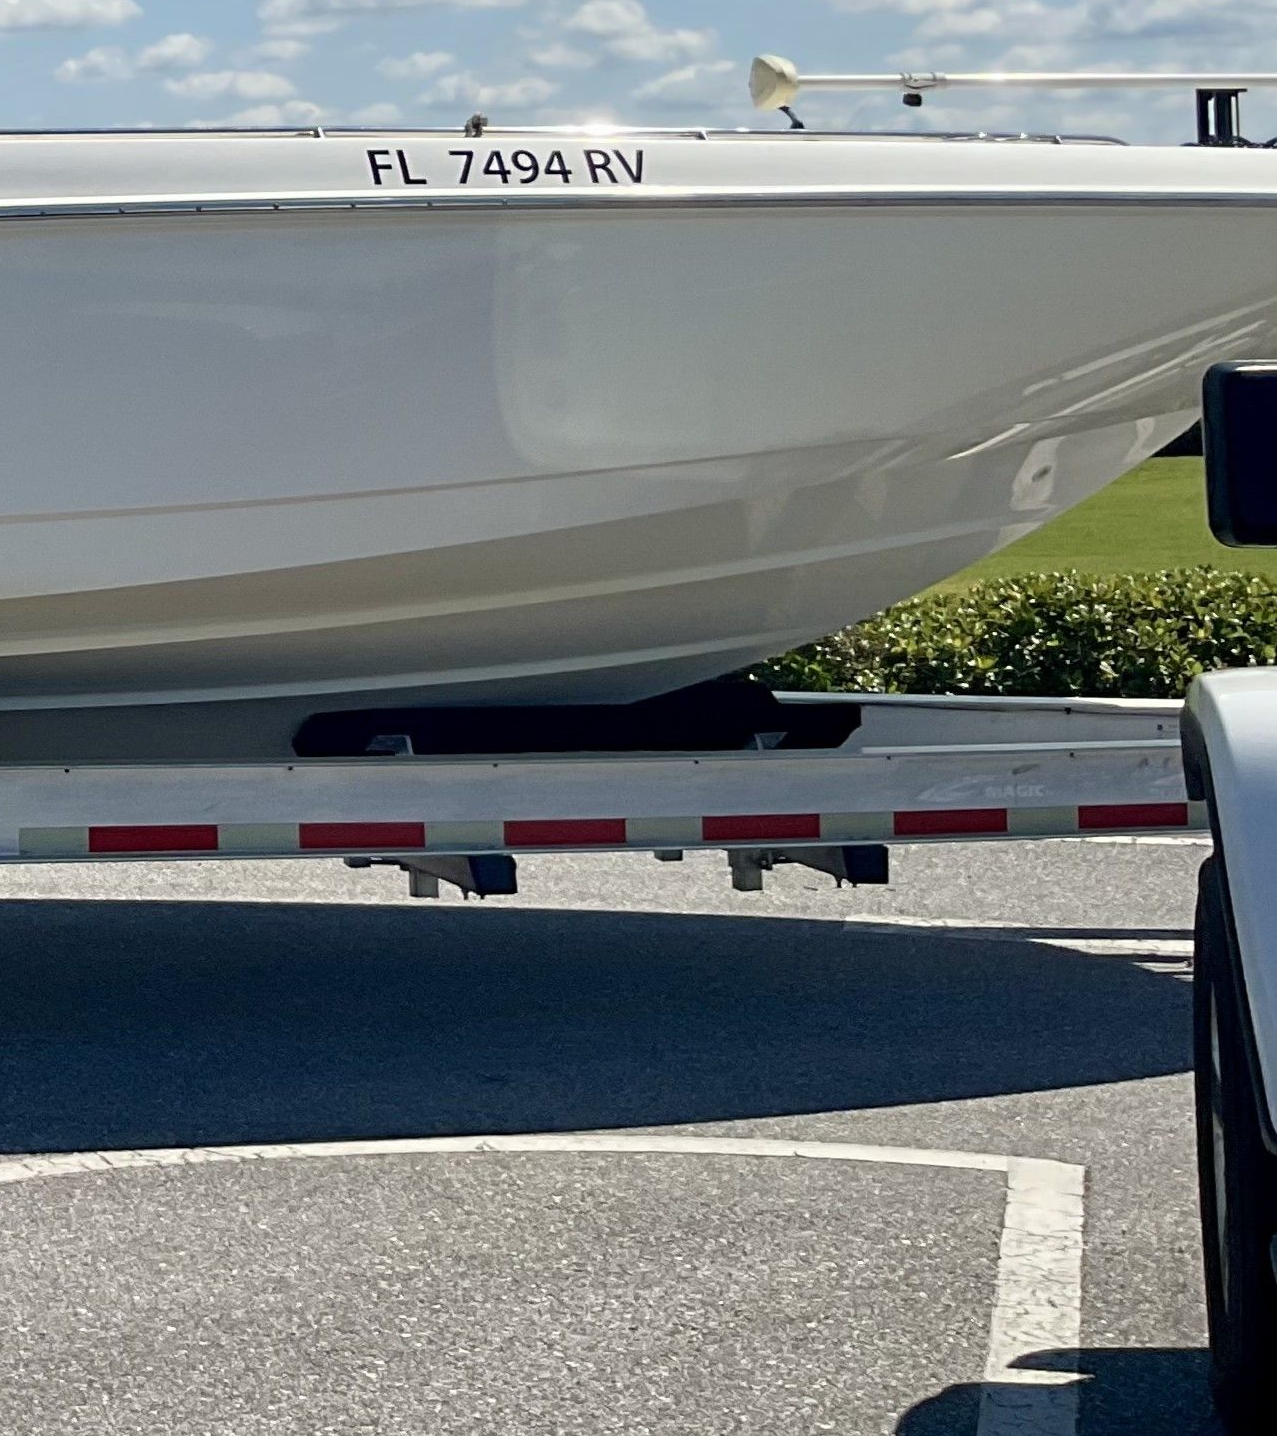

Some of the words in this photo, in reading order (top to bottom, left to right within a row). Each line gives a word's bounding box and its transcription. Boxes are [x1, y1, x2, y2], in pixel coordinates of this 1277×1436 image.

[367, 149, 427, 185] FL
[448, 149, 572, 184] 7494
[583, 149, 643, 184] RV
